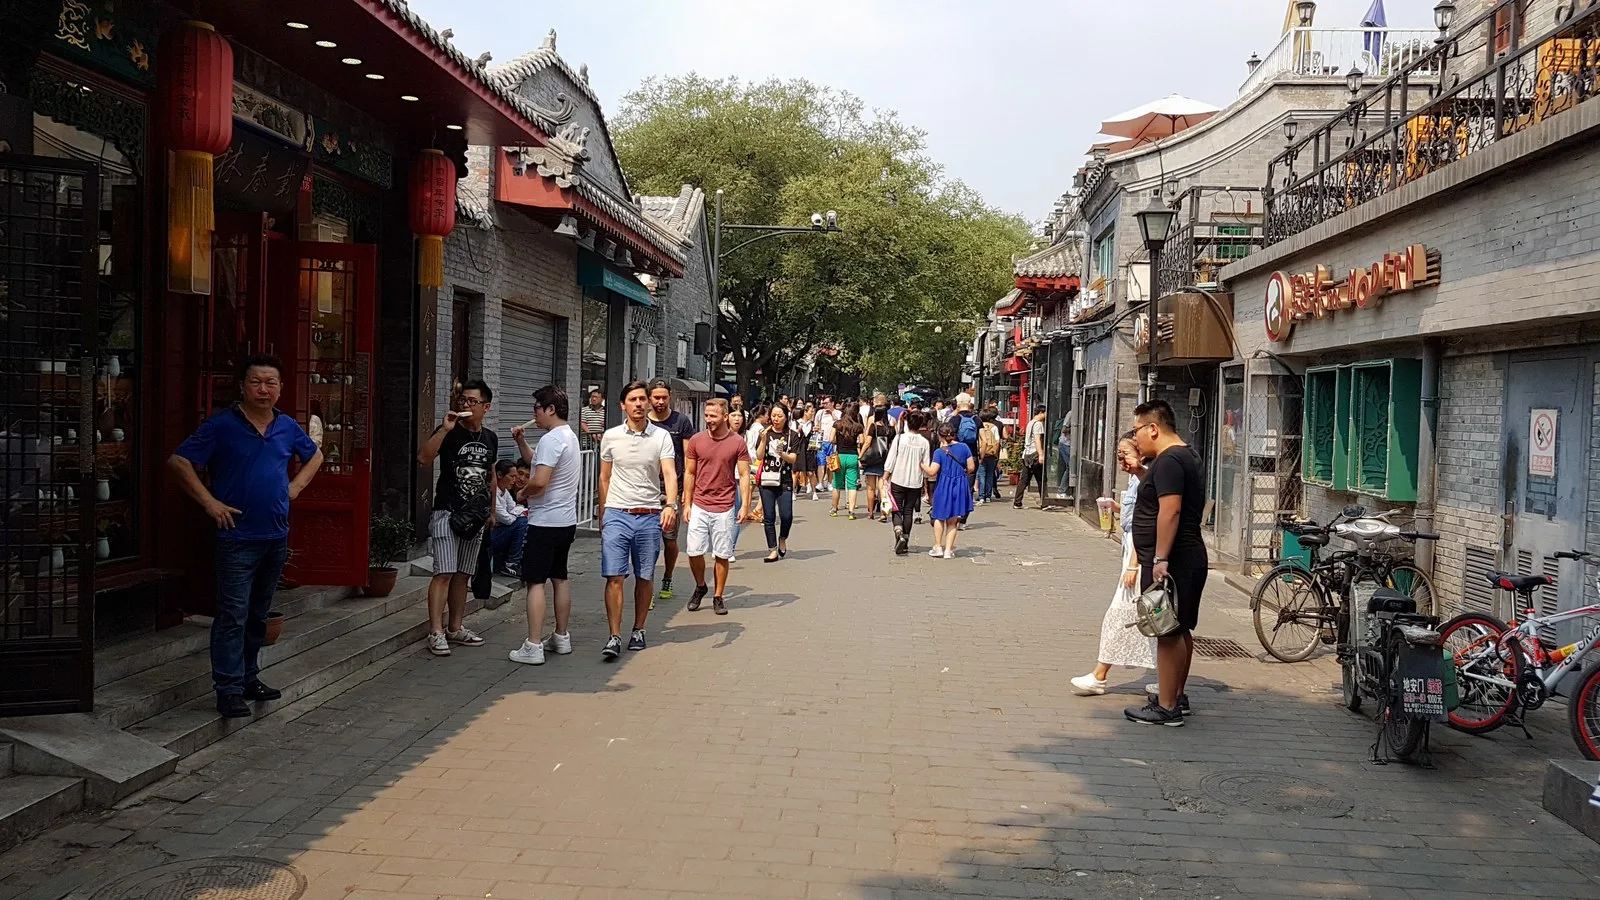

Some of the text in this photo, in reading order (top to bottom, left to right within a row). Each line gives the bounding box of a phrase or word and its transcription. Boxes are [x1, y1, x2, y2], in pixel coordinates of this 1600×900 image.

[1347, 244, 1419, 308] MODERN
[461, 446, 490, 456] BULLDO
[1403, 677, 1424, 692] 地安门
